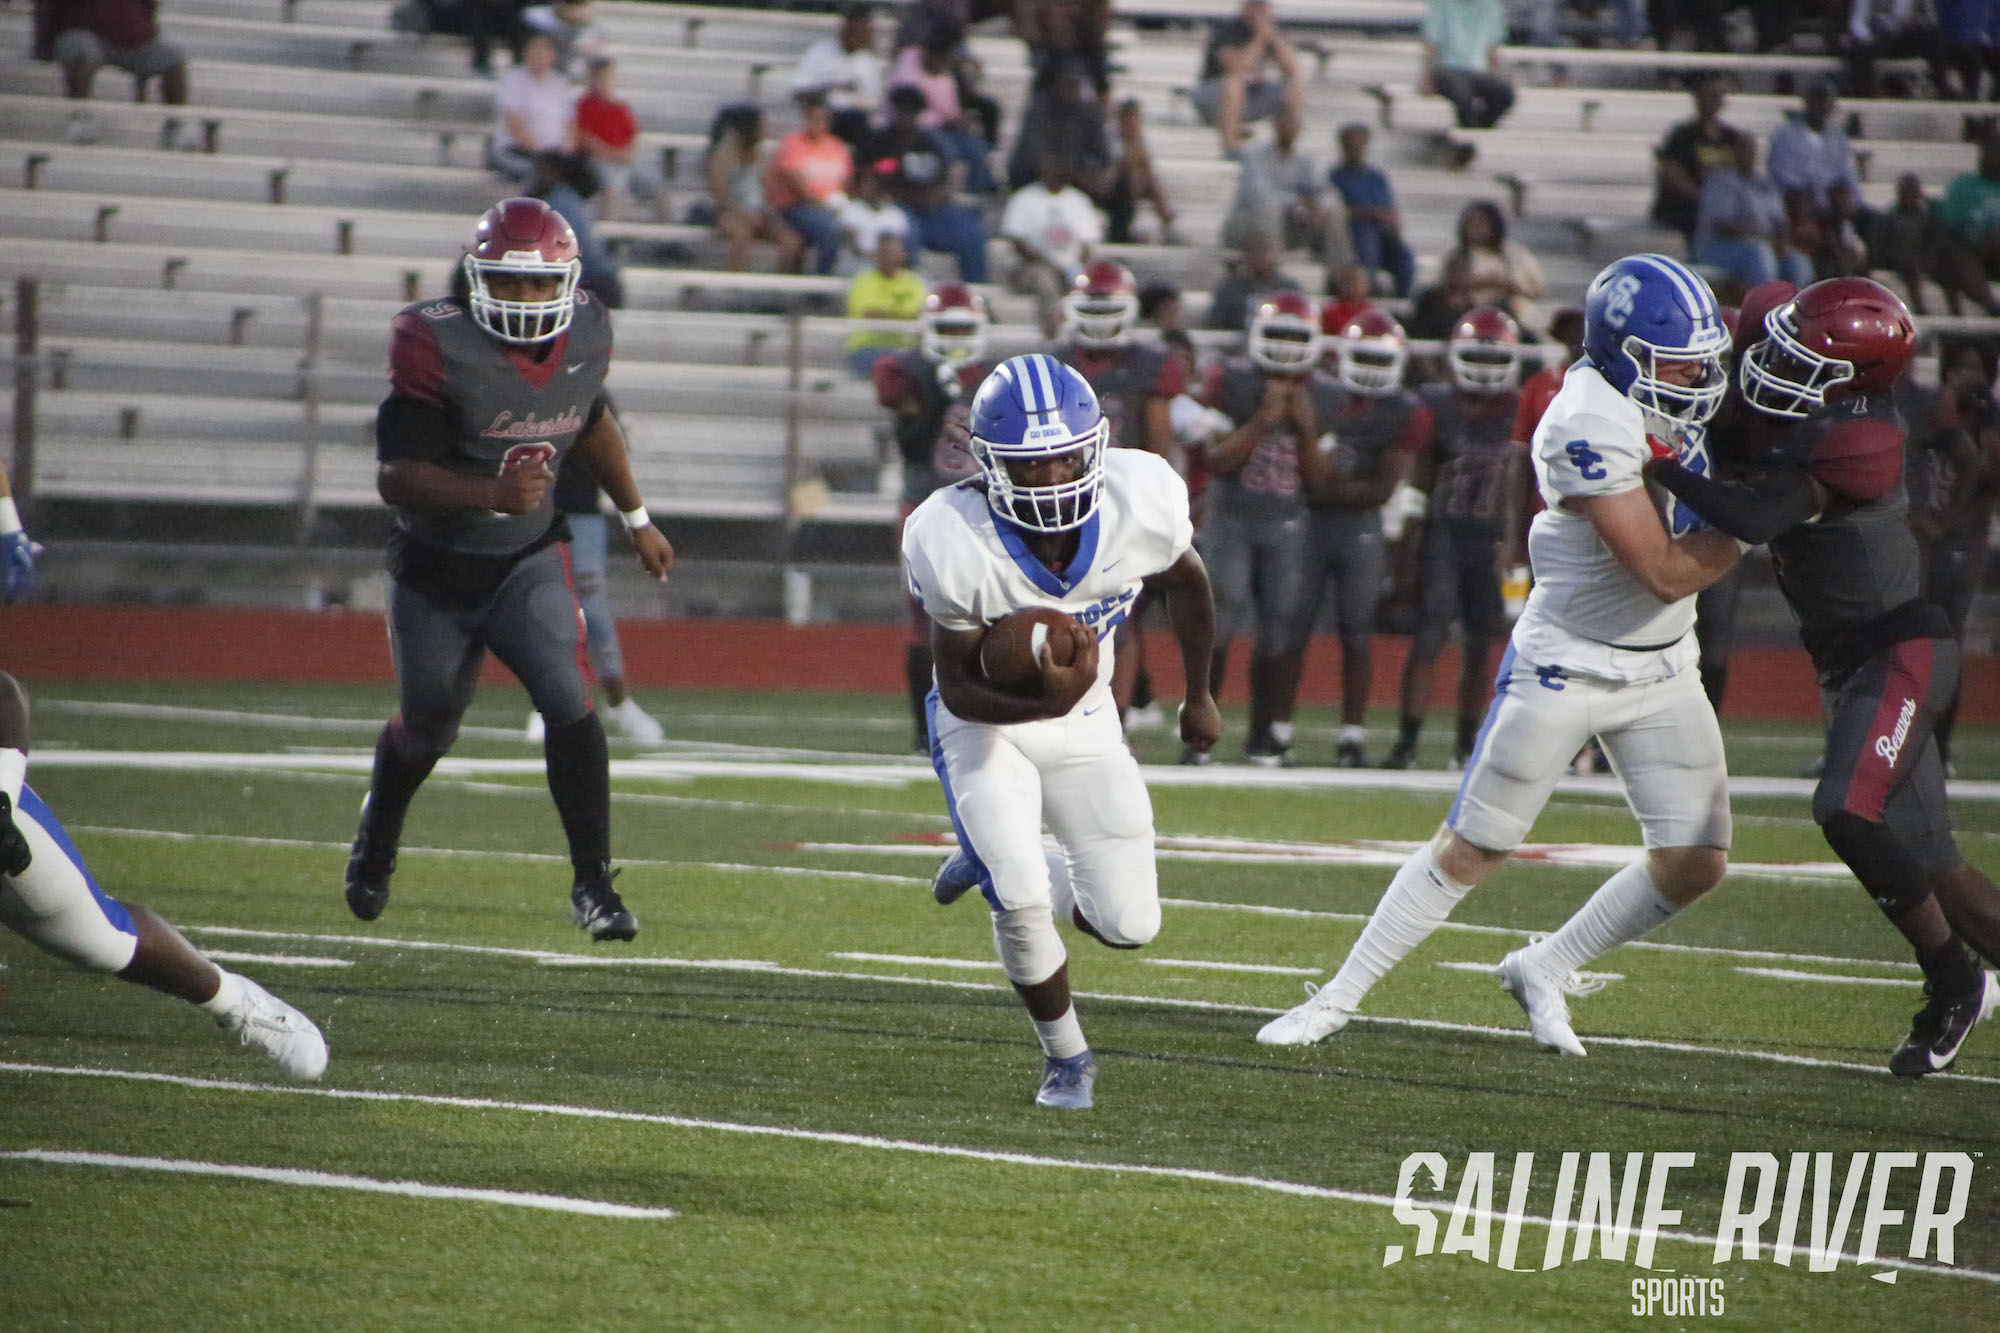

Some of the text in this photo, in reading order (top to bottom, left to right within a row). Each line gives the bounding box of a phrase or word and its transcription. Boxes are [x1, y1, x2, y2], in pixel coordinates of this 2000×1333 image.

[1605, 274, 1641, 329] SC
[479, 405, 582, 439] Lakeside
[1565, 439, 1608, 481] SC
[1875, 697, 1917, 769] Beavers
